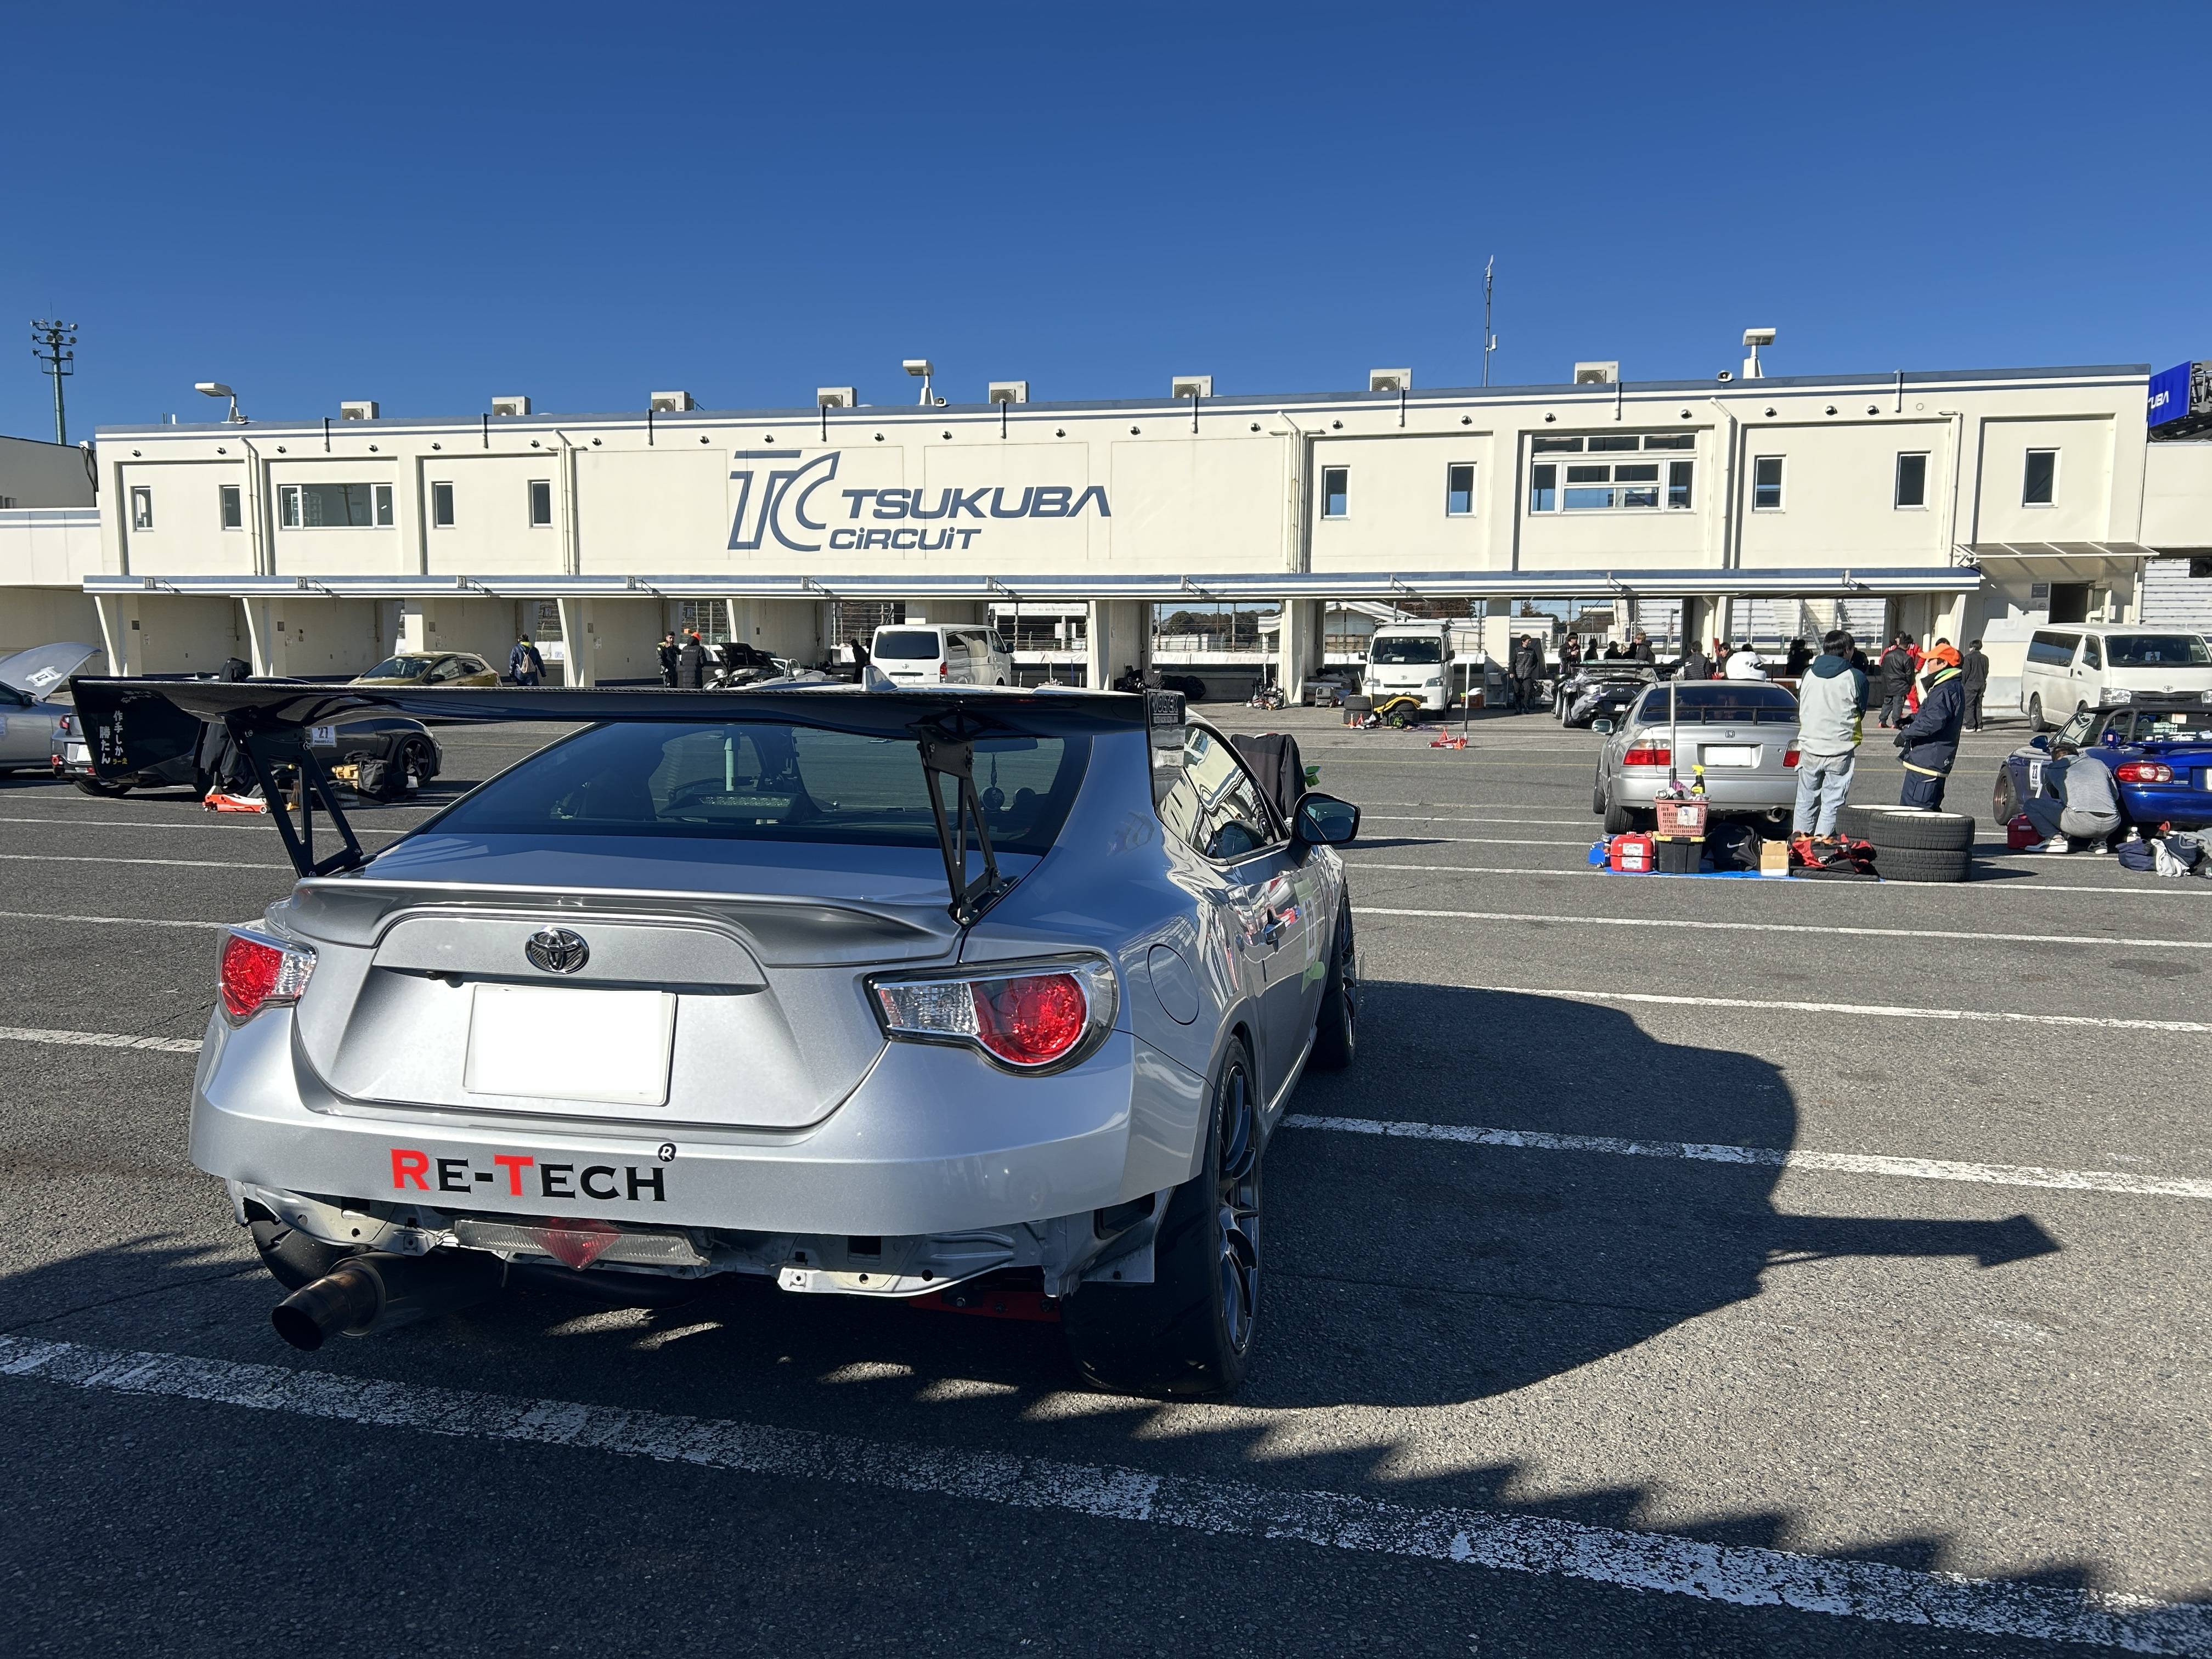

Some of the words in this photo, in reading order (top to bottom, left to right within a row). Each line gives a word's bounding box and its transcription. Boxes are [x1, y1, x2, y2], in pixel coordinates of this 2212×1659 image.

[2148, 390, 2169, 409] UBA
[727, 450, 842, 552] TC
[841, 485, 1112, 520] TSUKUBA
[300, 579, 304, 588] 2
[460, 578, 464, 587] 3
[629, 579, 633, 588] 5
[99, 725, 111, 764] 勝たん
[390, 1148, 668, 1202] RE-TECH
